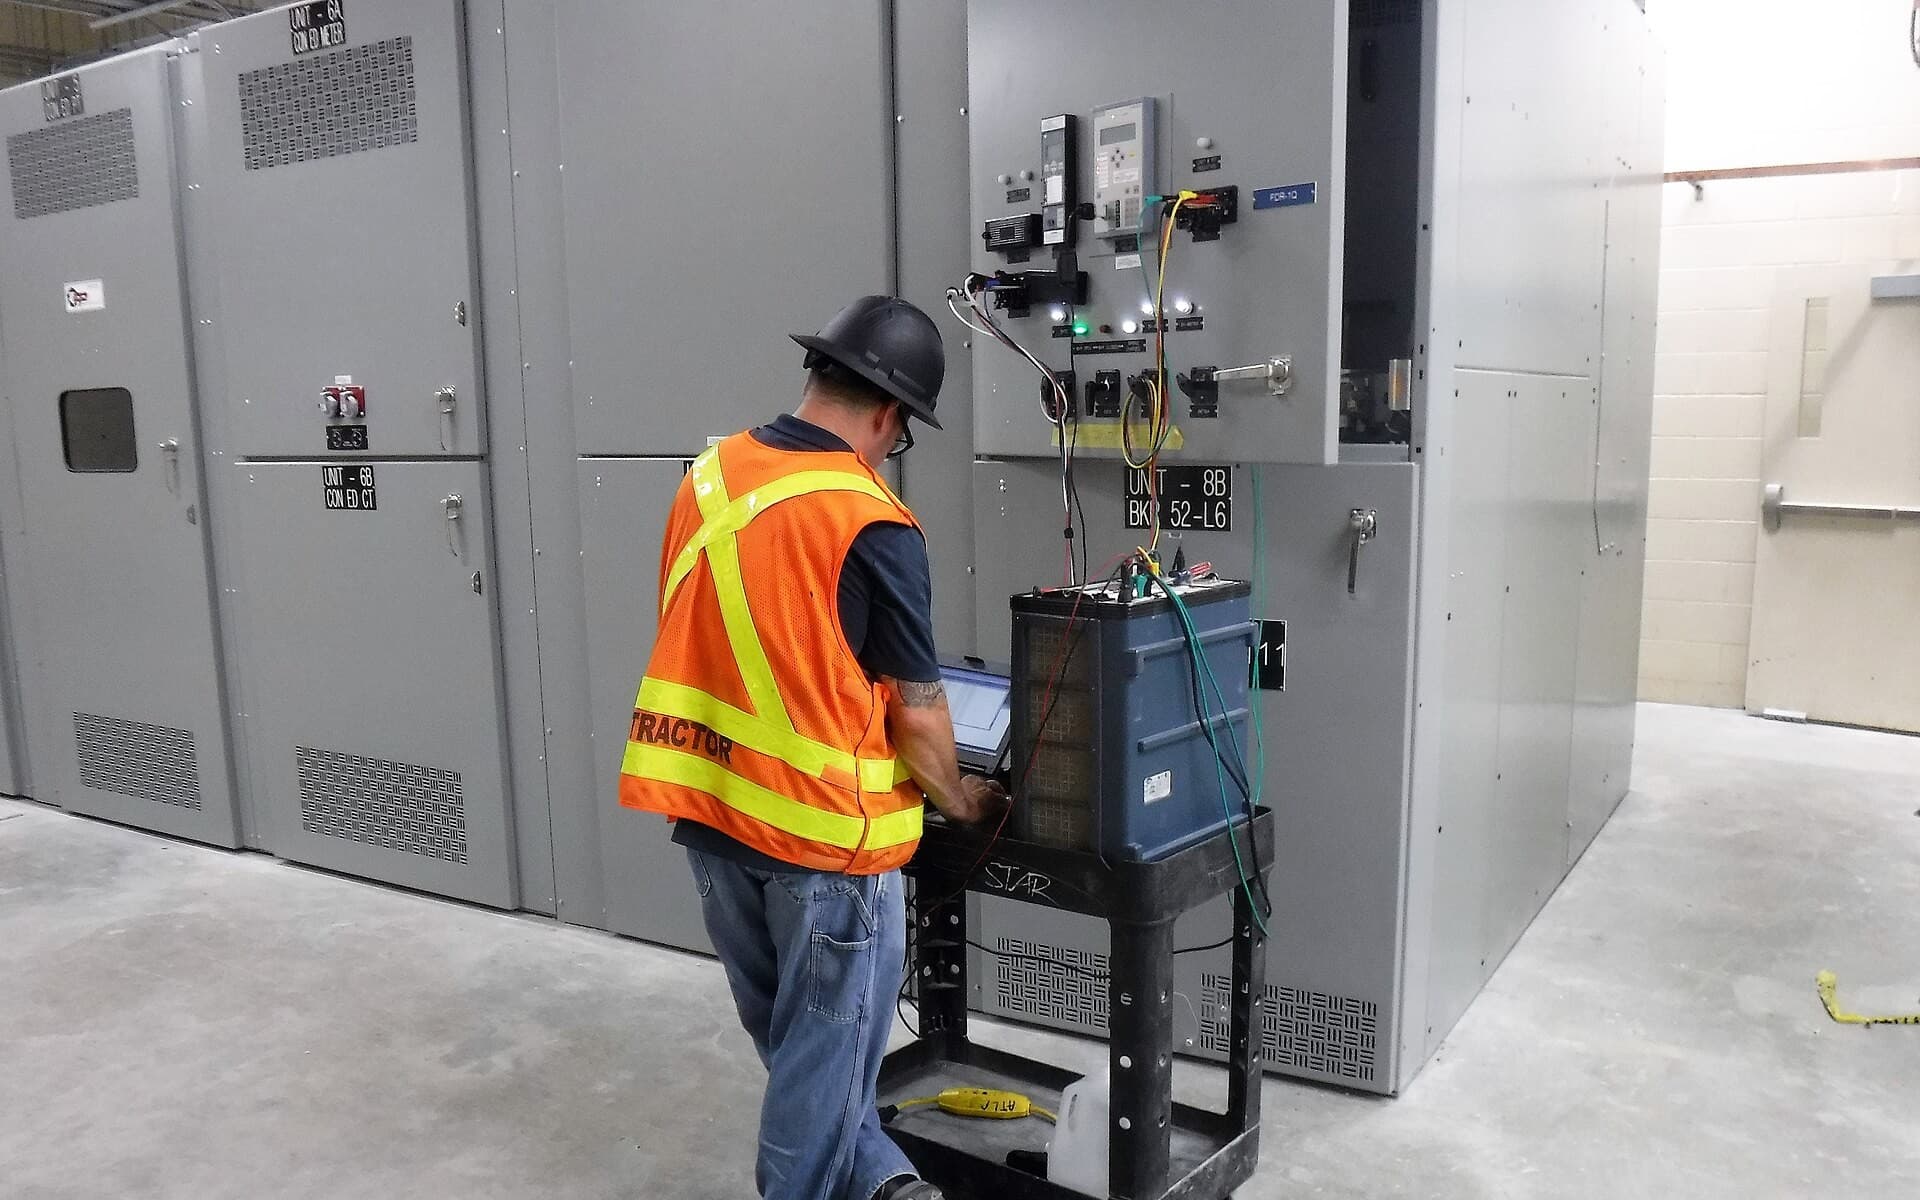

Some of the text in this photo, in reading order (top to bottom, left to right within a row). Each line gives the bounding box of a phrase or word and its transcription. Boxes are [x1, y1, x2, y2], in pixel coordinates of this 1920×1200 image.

[324, 467, 343, 486] UNIT
[360, 467, 372, 486] 6B
[1129, 468, 1167, 495] UNT
[1203, 469, 1226, 496] 8B
[326, 488, 373, 508] CON ED CT
[1170, 500, 1226, 528] 52-L6
[985, 861, 1057, 904] STAR
